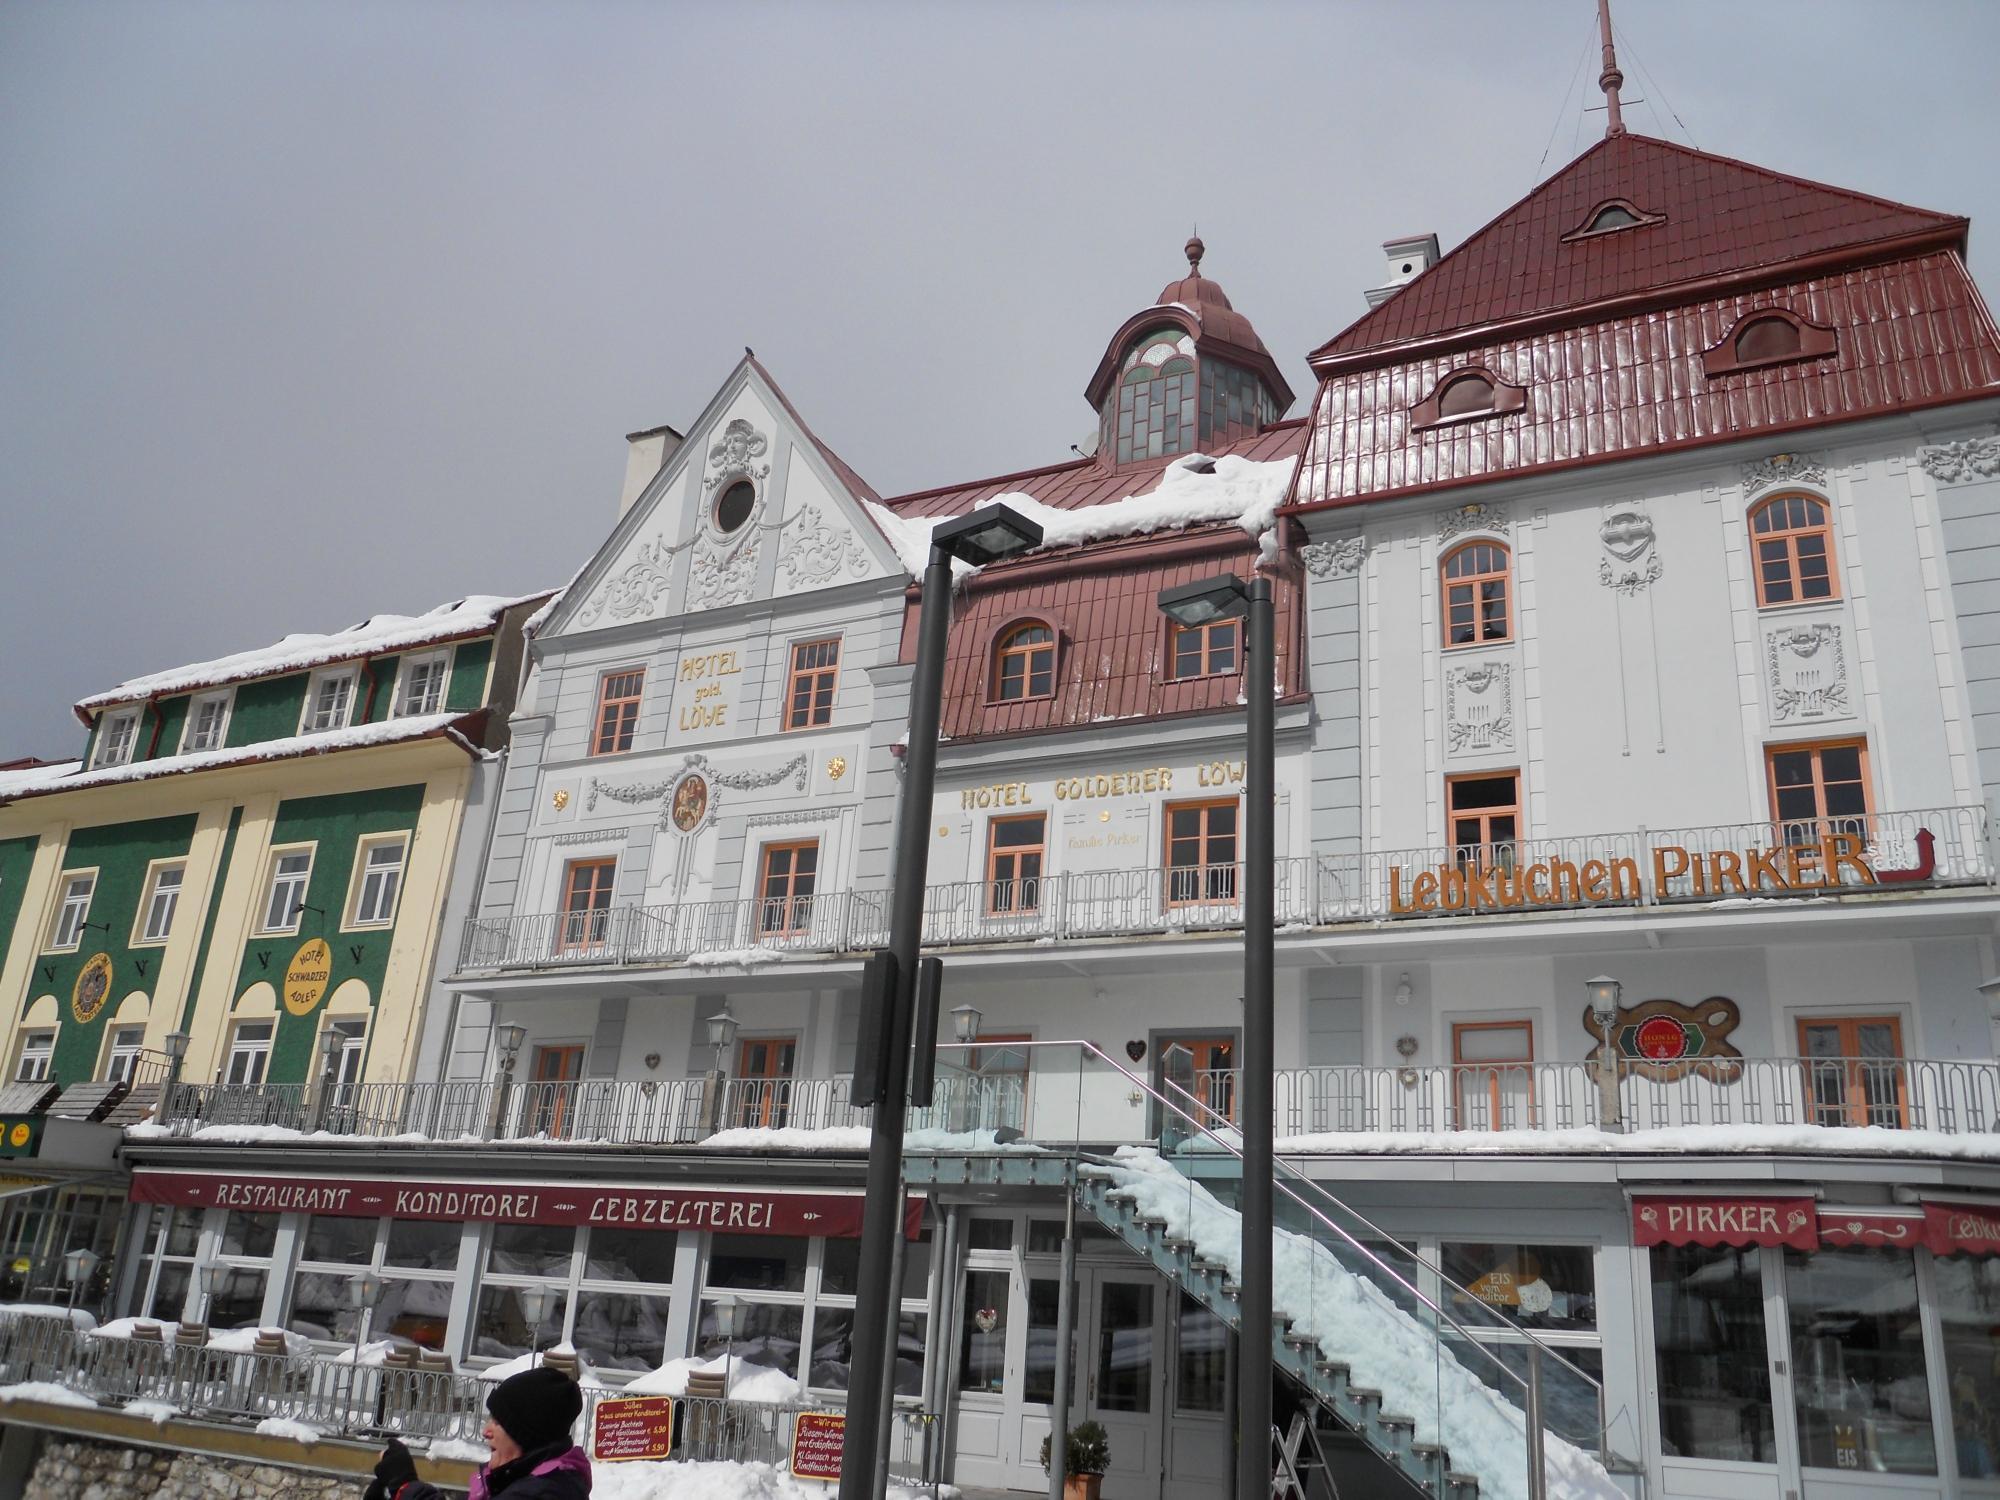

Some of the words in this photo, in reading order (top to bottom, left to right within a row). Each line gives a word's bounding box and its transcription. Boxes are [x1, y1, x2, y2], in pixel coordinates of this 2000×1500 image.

[680, 651, 741, 681] HOTEL
[680, 703, 728, 730] LÖWE
[961, 782, 1032, 809] HOTEL
[1055, 768, 1173, 800] GOLDENER
[1197, 760, 1246, 787] LÖW
[1389, 854, 1640, 914] Lebkuchen
[1652, 832, 1878, 898] PIRKER
[300, 950, 324, 966] HOTEL
[288, 971, 328, 983] SCHWARZER
[290, 989, 317, 1004] ADLER
[216, 1183, 352, 1212] RESTAURANT
[395, 1190, 539, 1219] KONDITOREI
[589, 1197, 774, 1228] LEBZELTEREI
[1668, 1206, 1782, 1234] PIRKER
[1949, 1214, 2000, 1241] Lebku
[1490, 1272, 1511, 1284] EIS
[1836, 1448, 1858, 1468] EIS
